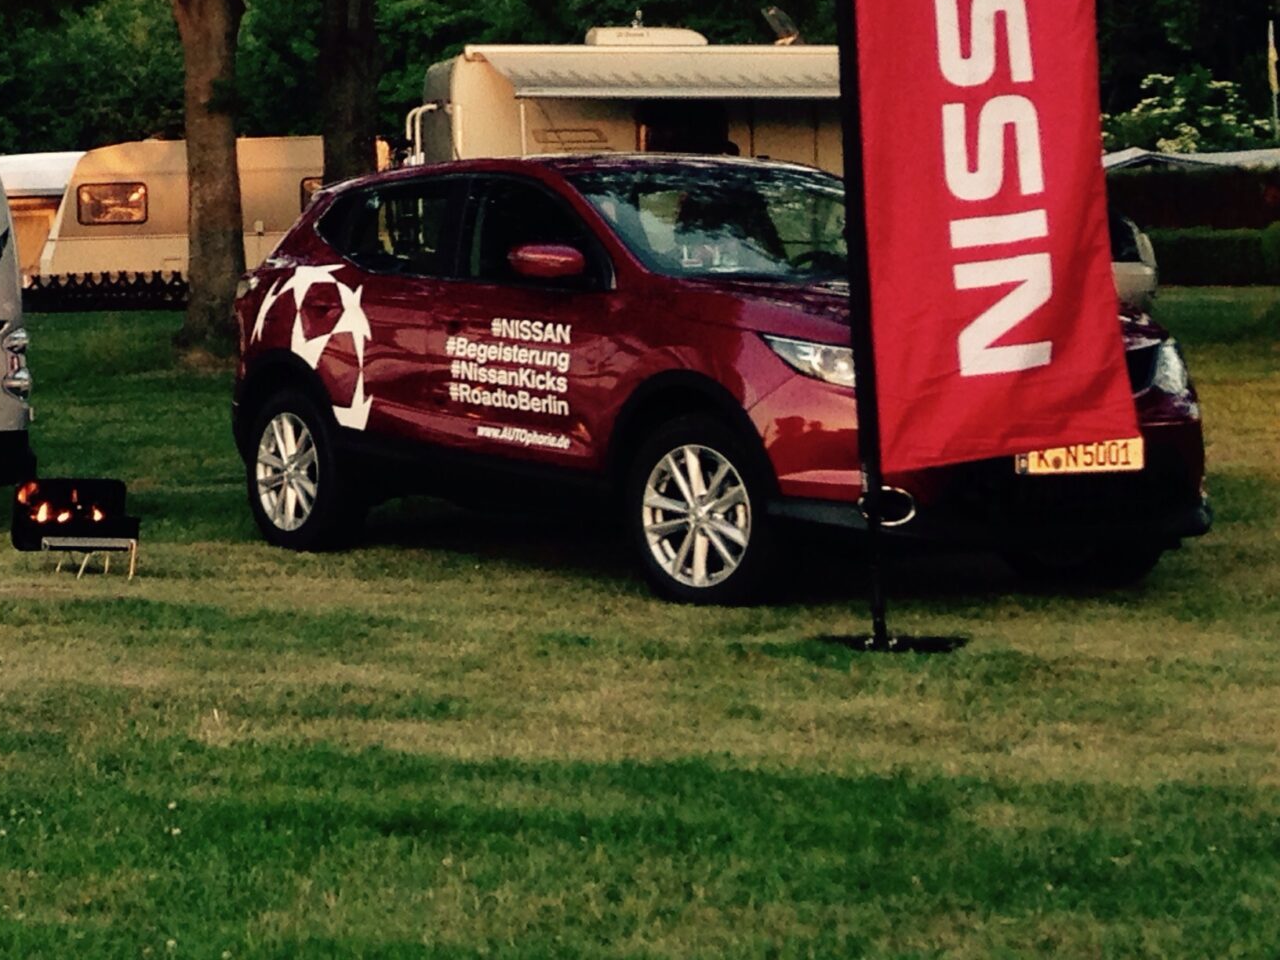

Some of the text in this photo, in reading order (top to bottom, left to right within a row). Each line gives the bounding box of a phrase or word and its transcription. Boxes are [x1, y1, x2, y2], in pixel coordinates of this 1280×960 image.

[491, 318, 571, 344] #NISSAN
[446, 337, 570, 373] #Begeisterung
[450, 360, 568, 393] #NissanKicks
[449, 382, 569, 416] #RoadtoBerlin
